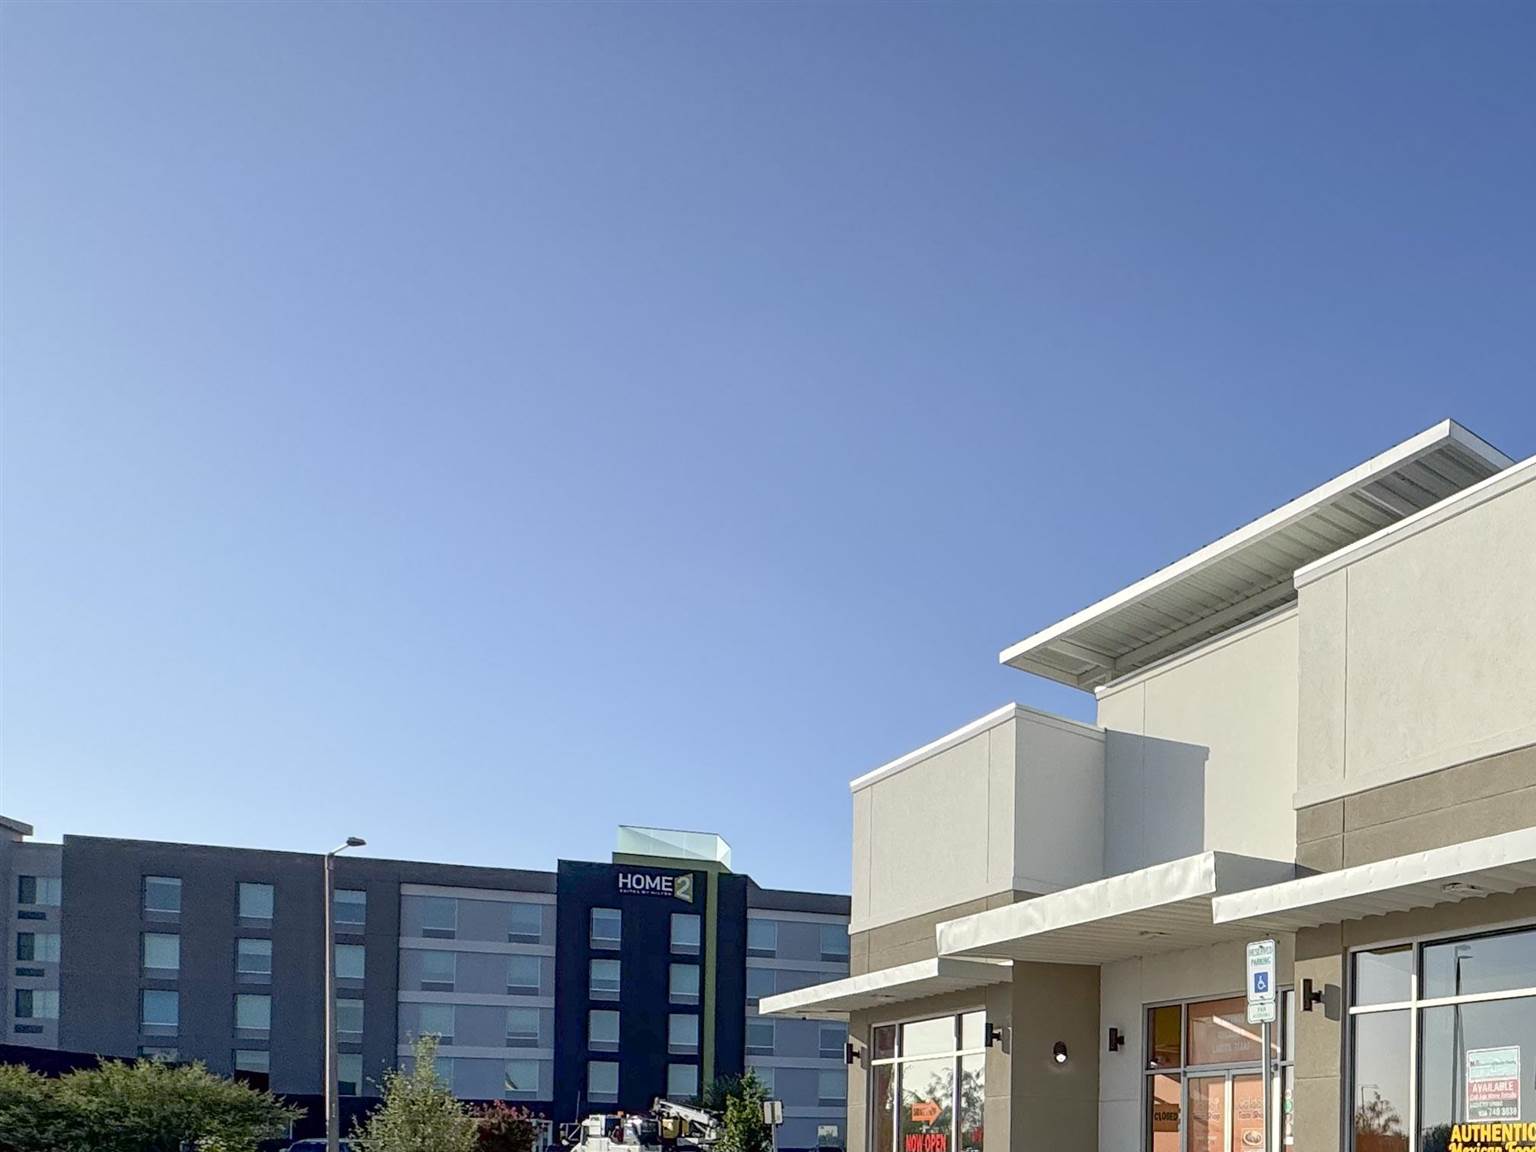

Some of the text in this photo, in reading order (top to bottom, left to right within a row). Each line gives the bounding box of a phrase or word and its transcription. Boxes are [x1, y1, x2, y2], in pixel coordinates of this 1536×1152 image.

[618, 873, 690, 899] HOME 2
[1472, 1081, 1514, 1093] AVAILABLE
[1154, 1111, 1178, 1120] CLOSED
[905, 1132, 946, 1152] NOW OPEN
